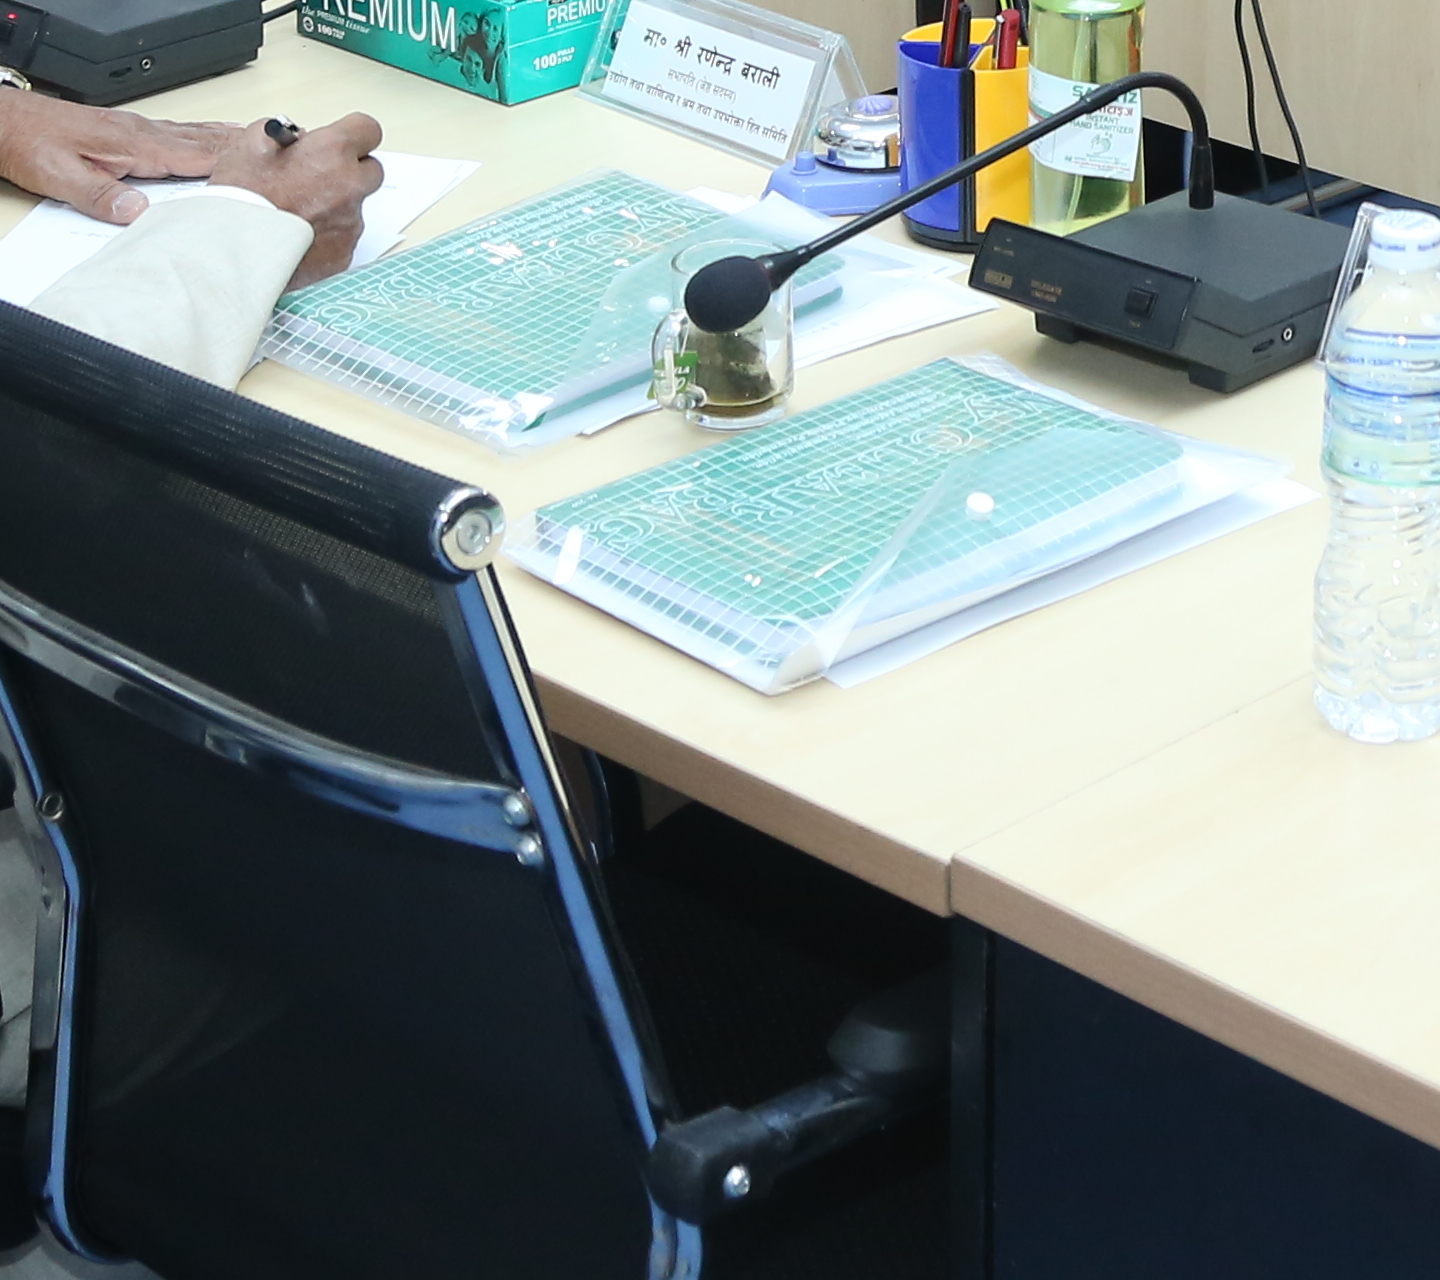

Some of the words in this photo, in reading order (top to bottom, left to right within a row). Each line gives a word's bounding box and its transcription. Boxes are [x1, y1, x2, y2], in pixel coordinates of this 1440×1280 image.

[533, 53, 557, 70] 100
[675, 36, 692, 58] श्री
[697, 46, 736, 76] रणेन्द्र
[741, 62, 781, 90] बराली
[1094, 123, 1134, 134] SANITIZER
